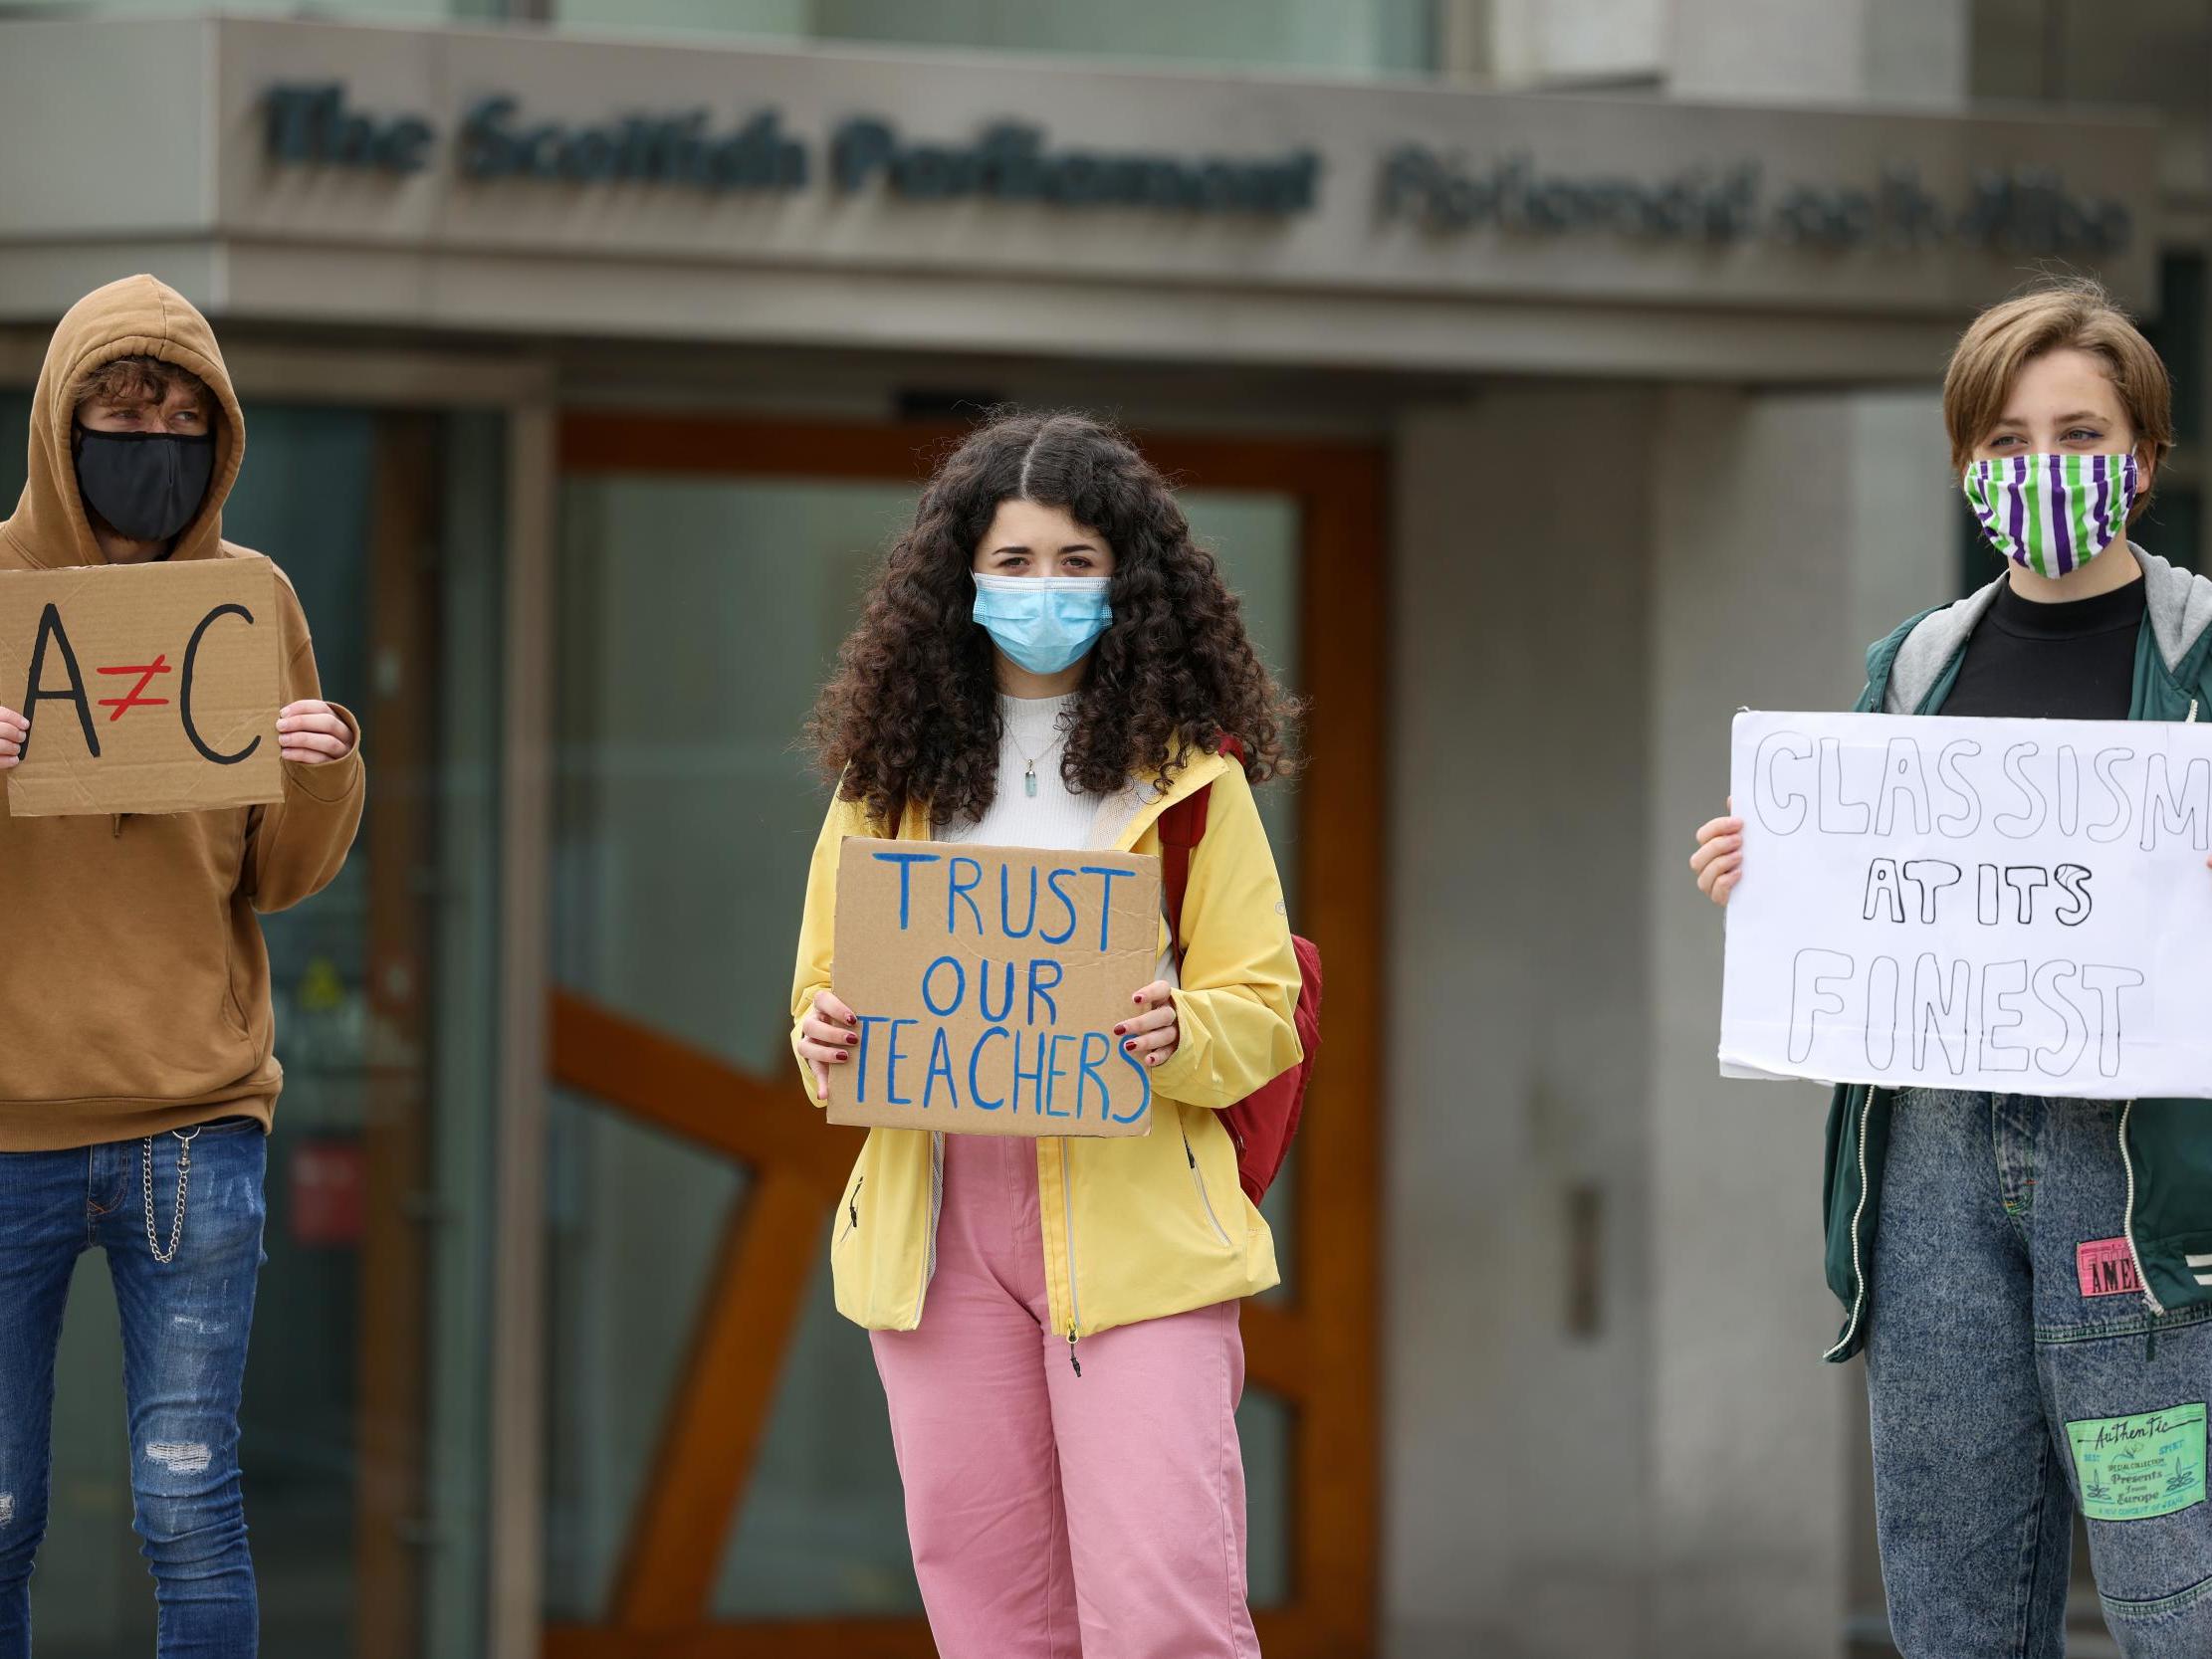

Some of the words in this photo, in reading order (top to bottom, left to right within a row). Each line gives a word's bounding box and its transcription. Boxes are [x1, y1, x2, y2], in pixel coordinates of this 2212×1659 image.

[1753, 730, 2211, 852] CLASSISM
[872, 852, 1137, 952] TRUST
[1863, 858, 1962, 925] AT
[1977, 863, 2093, 926] ITS
[922, 955, 1063, 1025] OUR
[1788, 948, 2144, 1078] FINEST
[856, 1015, 1151, 1124] TEACHERS
[2110, 1469, 2163, 1485] Presents
[2116, 1492, 2159, 1505] Europe
